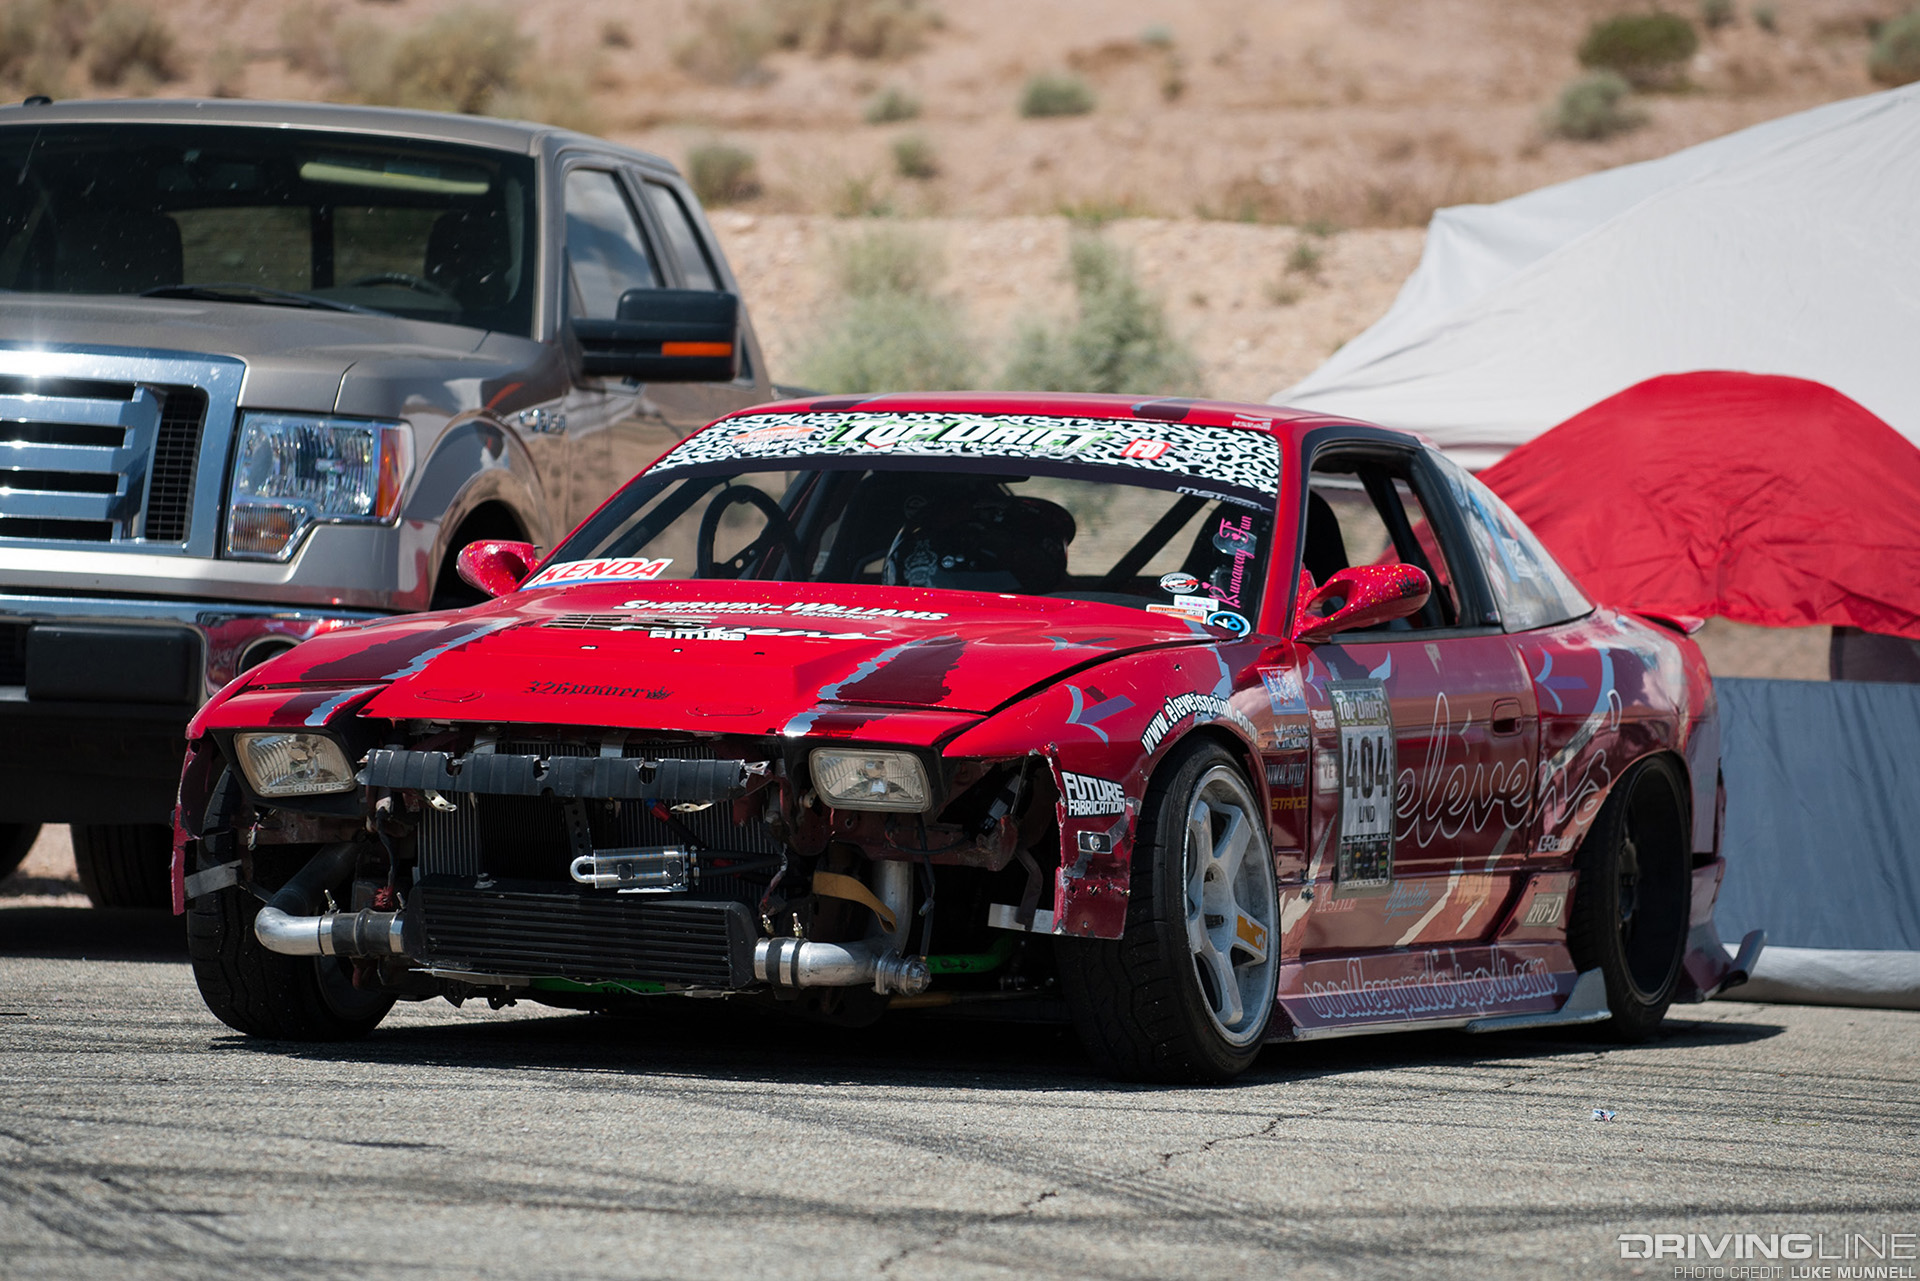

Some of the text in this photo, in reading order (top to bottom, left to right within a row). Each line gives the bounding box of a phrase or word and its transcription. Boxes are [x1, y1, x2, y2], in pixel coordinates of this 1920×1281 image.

[836, 420, 1107, 447] TOP DRIFT
[1125, 440, 1166, 459] FD
[530, 560, 667, 584] KENDA
[1207, 548, 1255, 609] Runaway
[613, 599, 949, 621] SHERWIN-WILLIAMS
[1336, 697, 1356, 720] TOP
[1355, 696, 1385, 720] DRIFT
[1345, 736, 1390, 799] 404
[1061, 772, 1125, 802] FUTURE
[1068, 799, 1126, 816] FABRICATION
